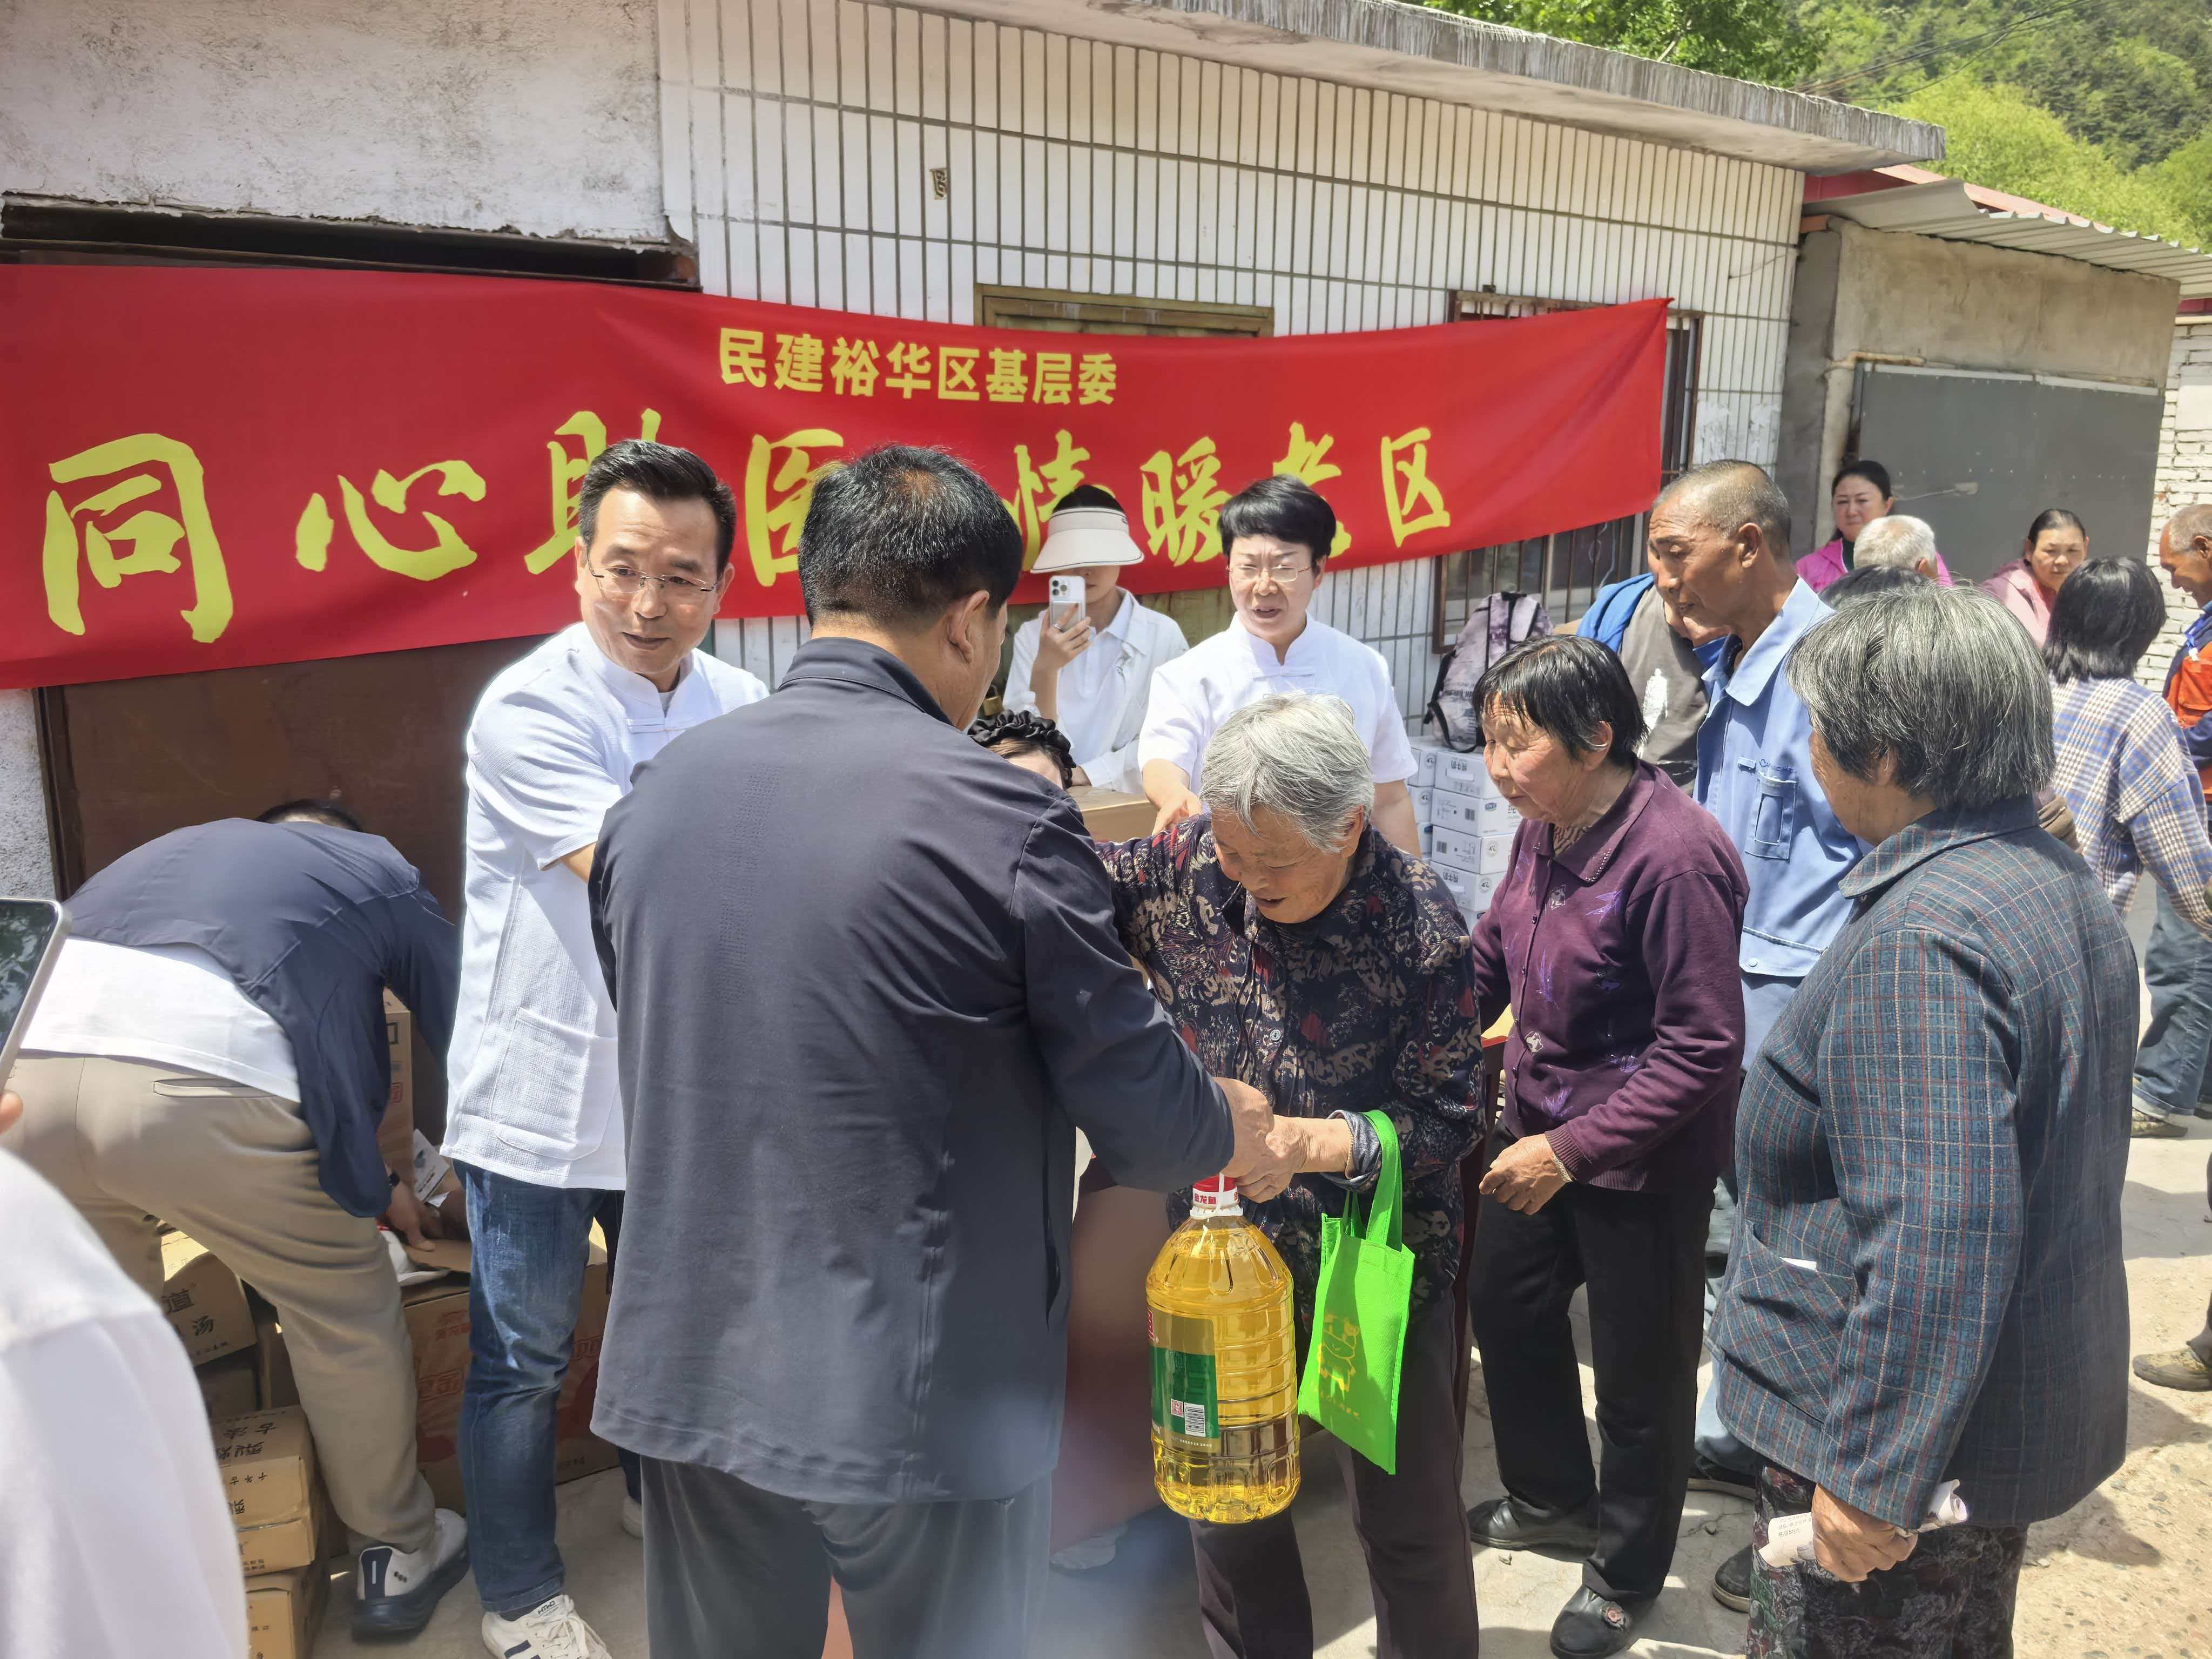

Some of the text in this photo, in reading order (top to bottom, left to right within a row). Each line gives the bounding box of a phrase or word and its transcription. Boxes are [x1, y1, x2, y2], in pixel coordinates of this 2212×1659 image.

[719, 327, 1117, 405] 民建裕华区基层委
